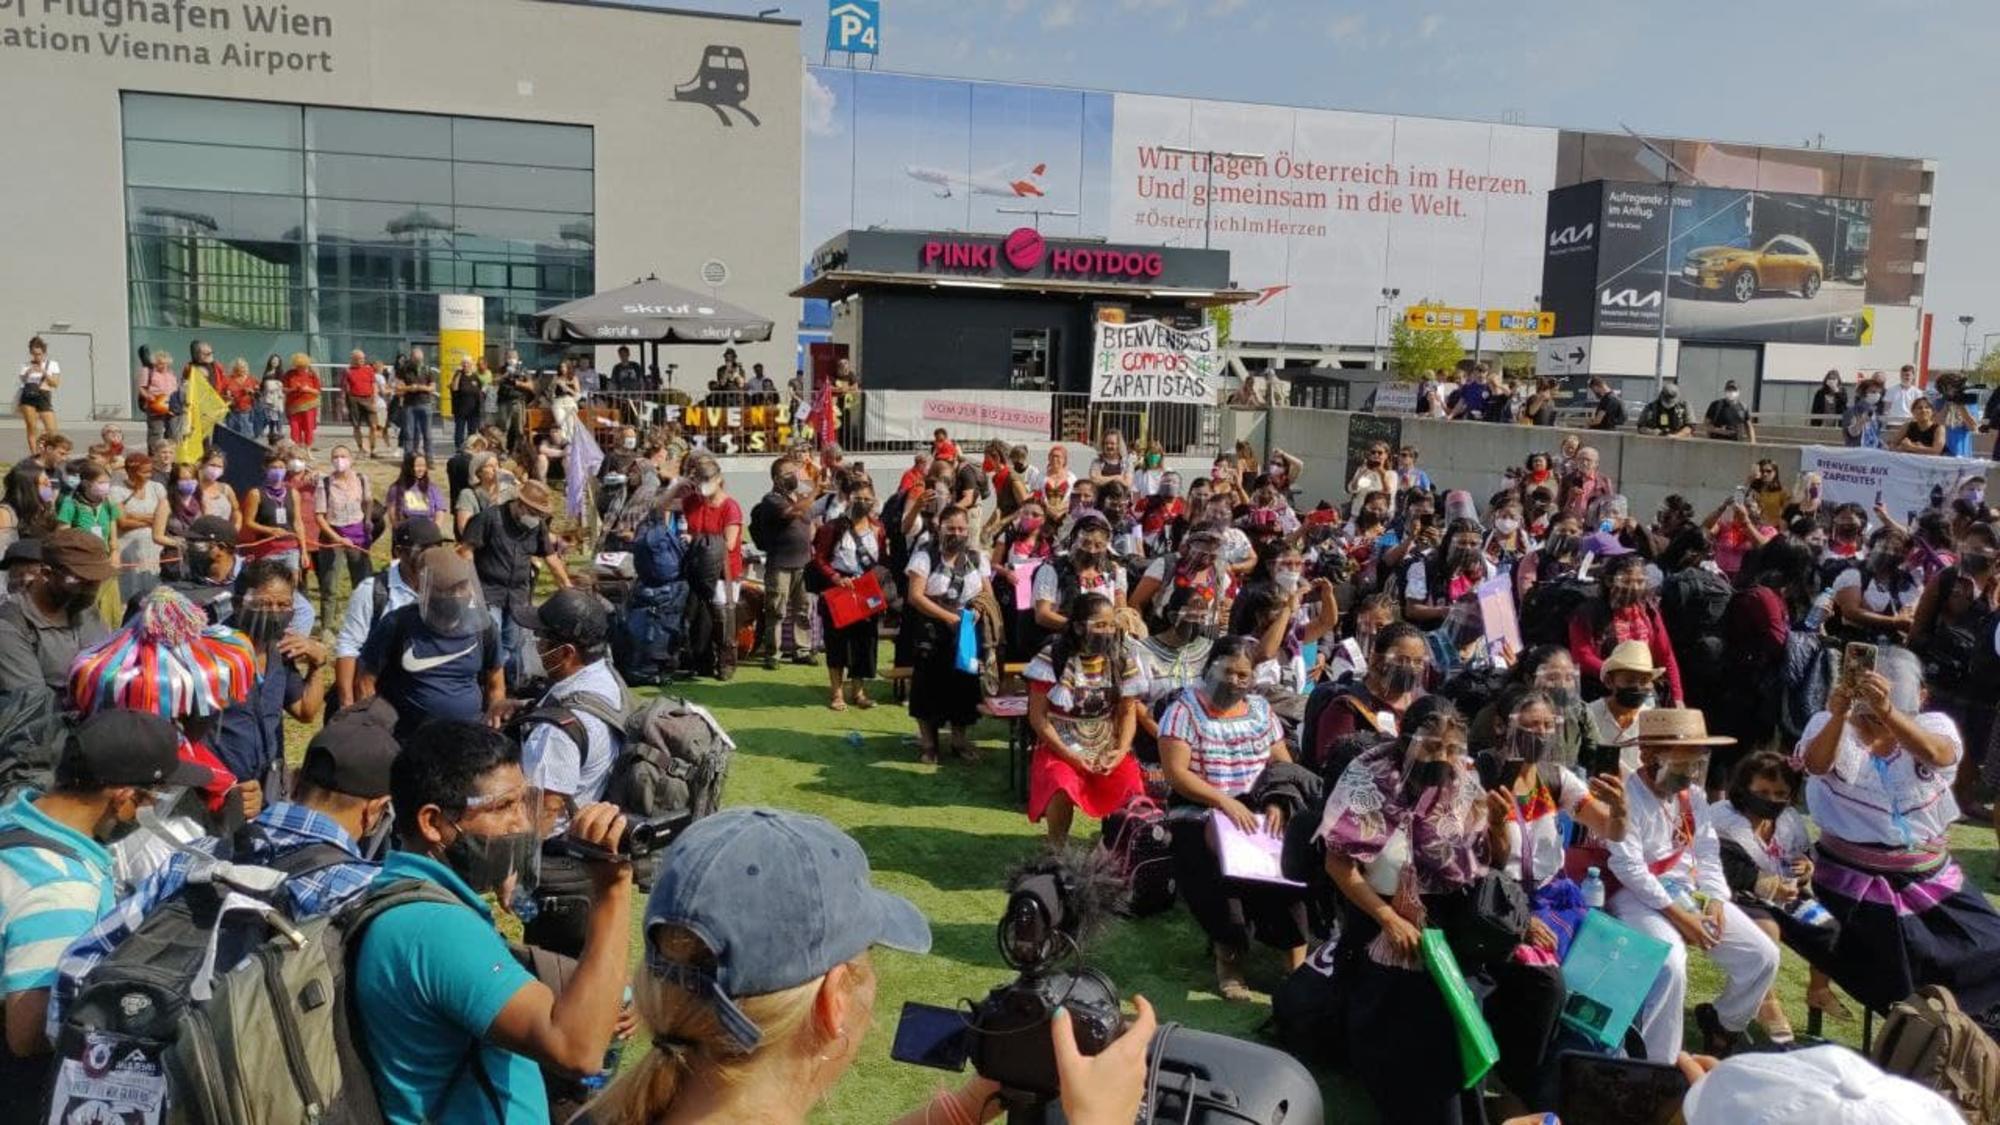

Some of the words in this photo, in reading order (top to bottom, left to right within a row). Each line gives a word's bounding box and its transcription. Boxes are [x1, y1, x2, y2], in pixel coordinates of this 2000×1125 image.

[243, 4, 332, 37] Wien
[0, 23, 90, 53] ation
[98, 31, 211, 66] Vienna
[221, 42, 333, 75] Airport
[1138, 146, 1183, 171] Wir
[1192, 152, 1268, 180] tragen
[1275, 151, 1399, 185] Österreich
[1409, 165, 1438, 187] im
[1447, 168, 1533, 195] Herzen.
[1138, 176, 1185, 200] Und
[1193, 183, 1327, 208] gemeinsam
[1338, 188, 1359, 211] in
[1368, 191, 1402, 213] die
[1412, 193, 1467, 217] Welt.
[924, 241, 997, 269] PINKI
[1053, 249, 1163, 277] HOTDOG
[1101, 374, 1206, 398] ZAPATISTAS
[1817, 459, 1867, 475] BIENVENUE
[1870, 466, 1889, 476] AUX
